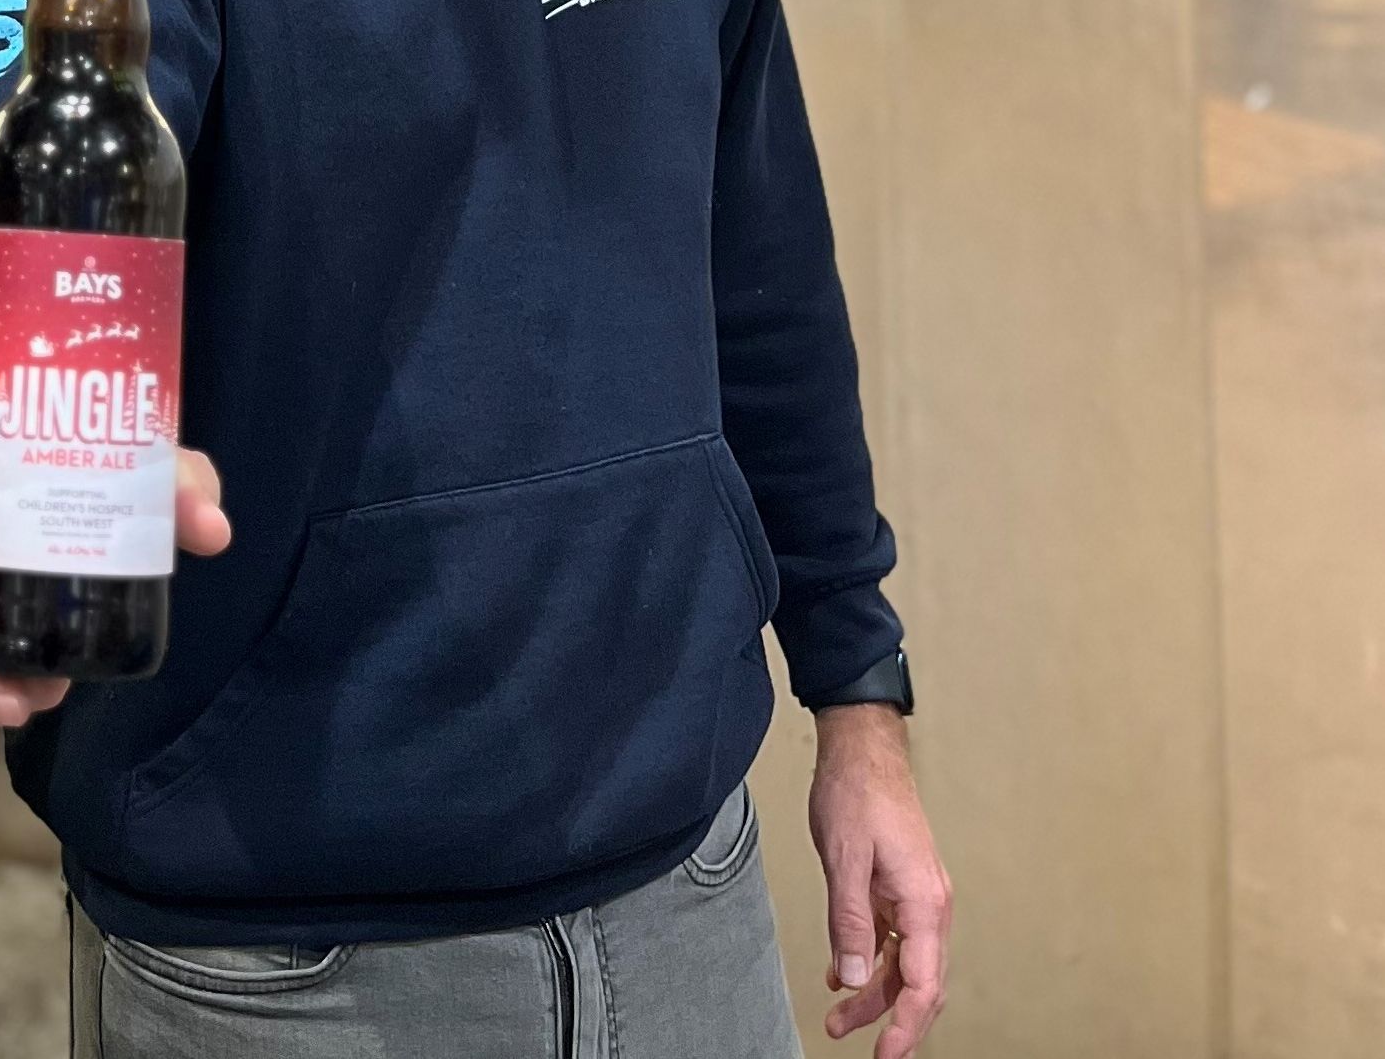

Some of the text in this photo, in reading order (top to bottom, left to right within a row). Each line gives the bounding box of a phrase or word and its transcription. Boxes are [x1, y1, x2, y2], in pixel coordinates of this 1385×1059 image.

[55, 270, 123, 300] BAYS
[22, 448, 137, 470] AMBER ALE
[17, 499, 135, 516] CHILDREN'S HOSPICE
[39, 516, 114, 530] SOUTH WEST
